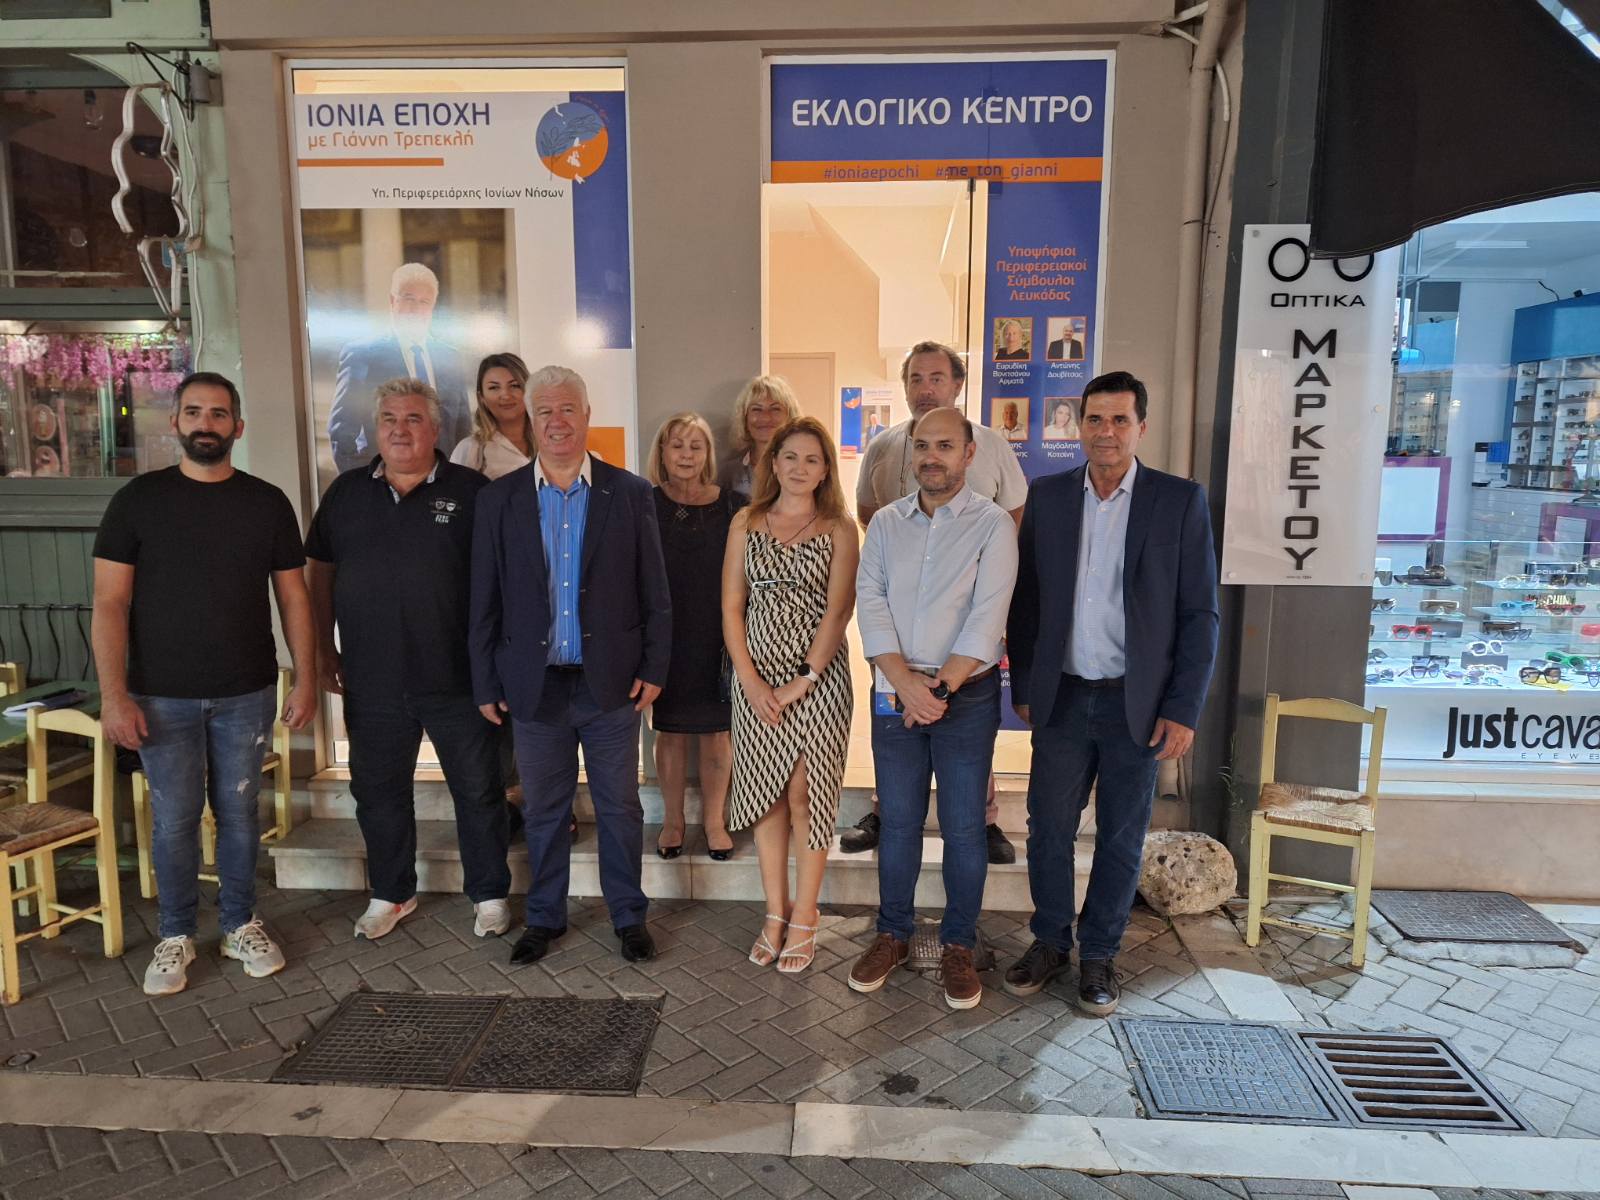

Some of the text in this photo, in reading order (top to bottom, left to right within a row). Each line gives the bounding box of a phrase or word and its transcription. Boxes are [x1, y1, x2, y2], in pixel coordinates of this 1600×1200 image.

[307, 102, 491, 127] ΙΟΝΙΑ ΕΠΟΧΗ
[792, 95, 1093, 126] ΕΚΛΟΓΙΚΟ ΚΕΝΤΡΟ
[308, 129, 474, 150] με Γιάννη Τρεπεκλή
[824, 165, 919, 179] #ioniaepochi
[372, 187, 564, 200] Υπ. Περιφερειάρχης Ιονίων Νήσων
[1008, 244, 1076, 259] Υποψήφιοι
[996, 259, 1088, 274] Περιφερειακοί
[1007, 274, 1075, 288] Σύμβουλοι
[1009, 289, 1071, 302] Λευκάδας
[1283, 328, 1337, 571] ΜΑΡΚΕΤΟΥ
